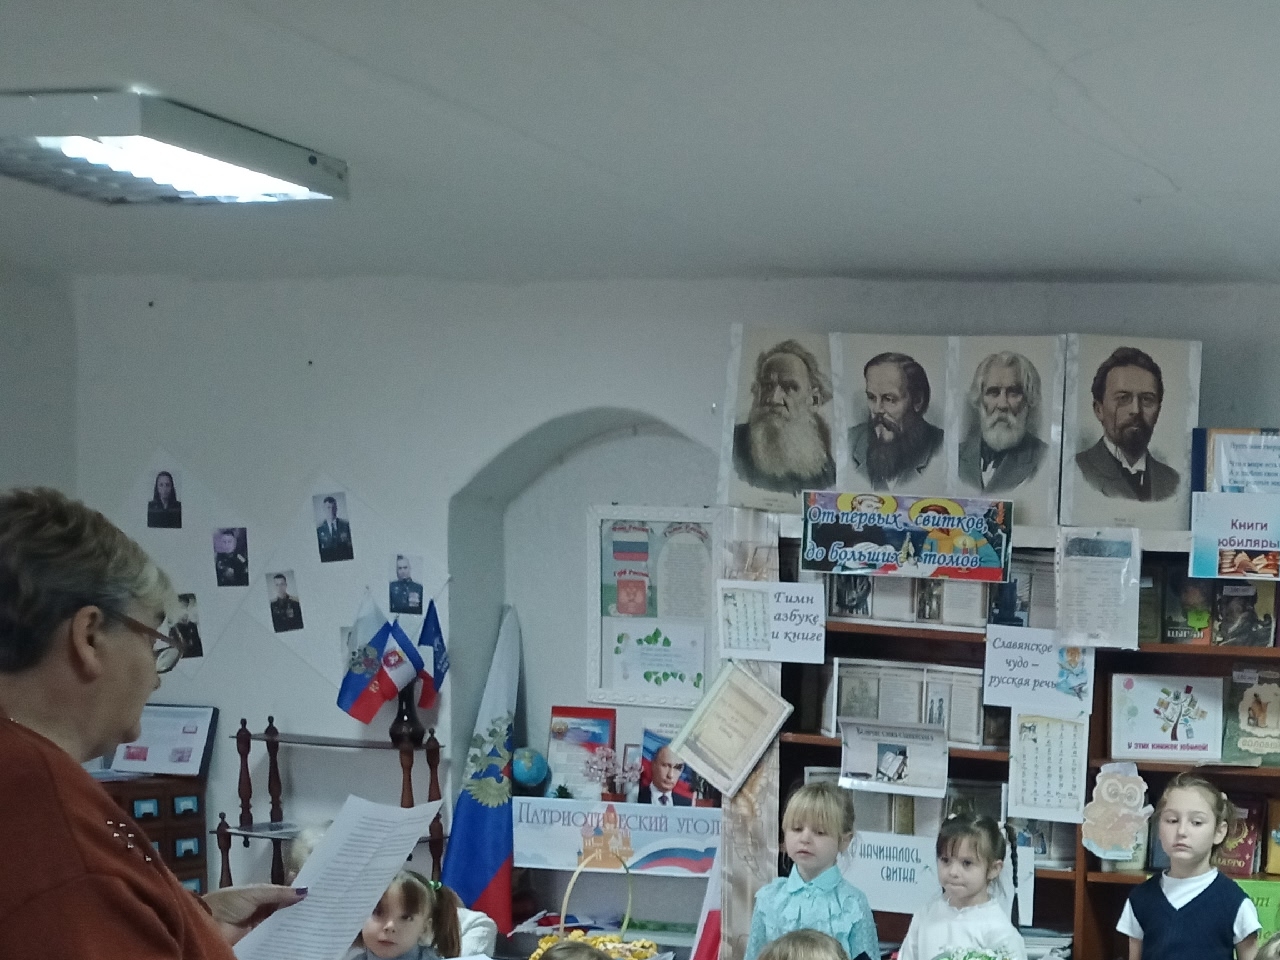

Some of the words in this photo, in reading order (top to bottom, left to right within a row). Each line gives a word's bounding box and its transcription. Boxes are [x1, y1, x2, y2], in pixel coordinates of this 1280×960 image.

[808, 506, 836, 524] От
[840, 511, 902, 531] первых
[915, 513, 988, 533] свитков,
[1230, 519, 1268, 531] Книги
[1217, 536, 1280, 549] юбиляры
[805, 541, 826, 560] до
[829, 542, 902, 564] больших
[773, 591, 815, 605] Гимн
[773, 608, 820, 626] азбуке
[771, 630, 780, 640] и
[783, 631, 823, 643] книге
[992, 637, 1053, 654] Славянское
[1005, 656, 1029, 672] чудо
[987, 675, 1030, 688] русская
[1031, 678, 1057, 691] речь
[518, 802, 668, 833] ПАТРИОТИЕСКИЙ
[859, 842, 921, 863] НАЧИНАЛОСЬ
[880, 866, 918, 884] СВИТКА.
